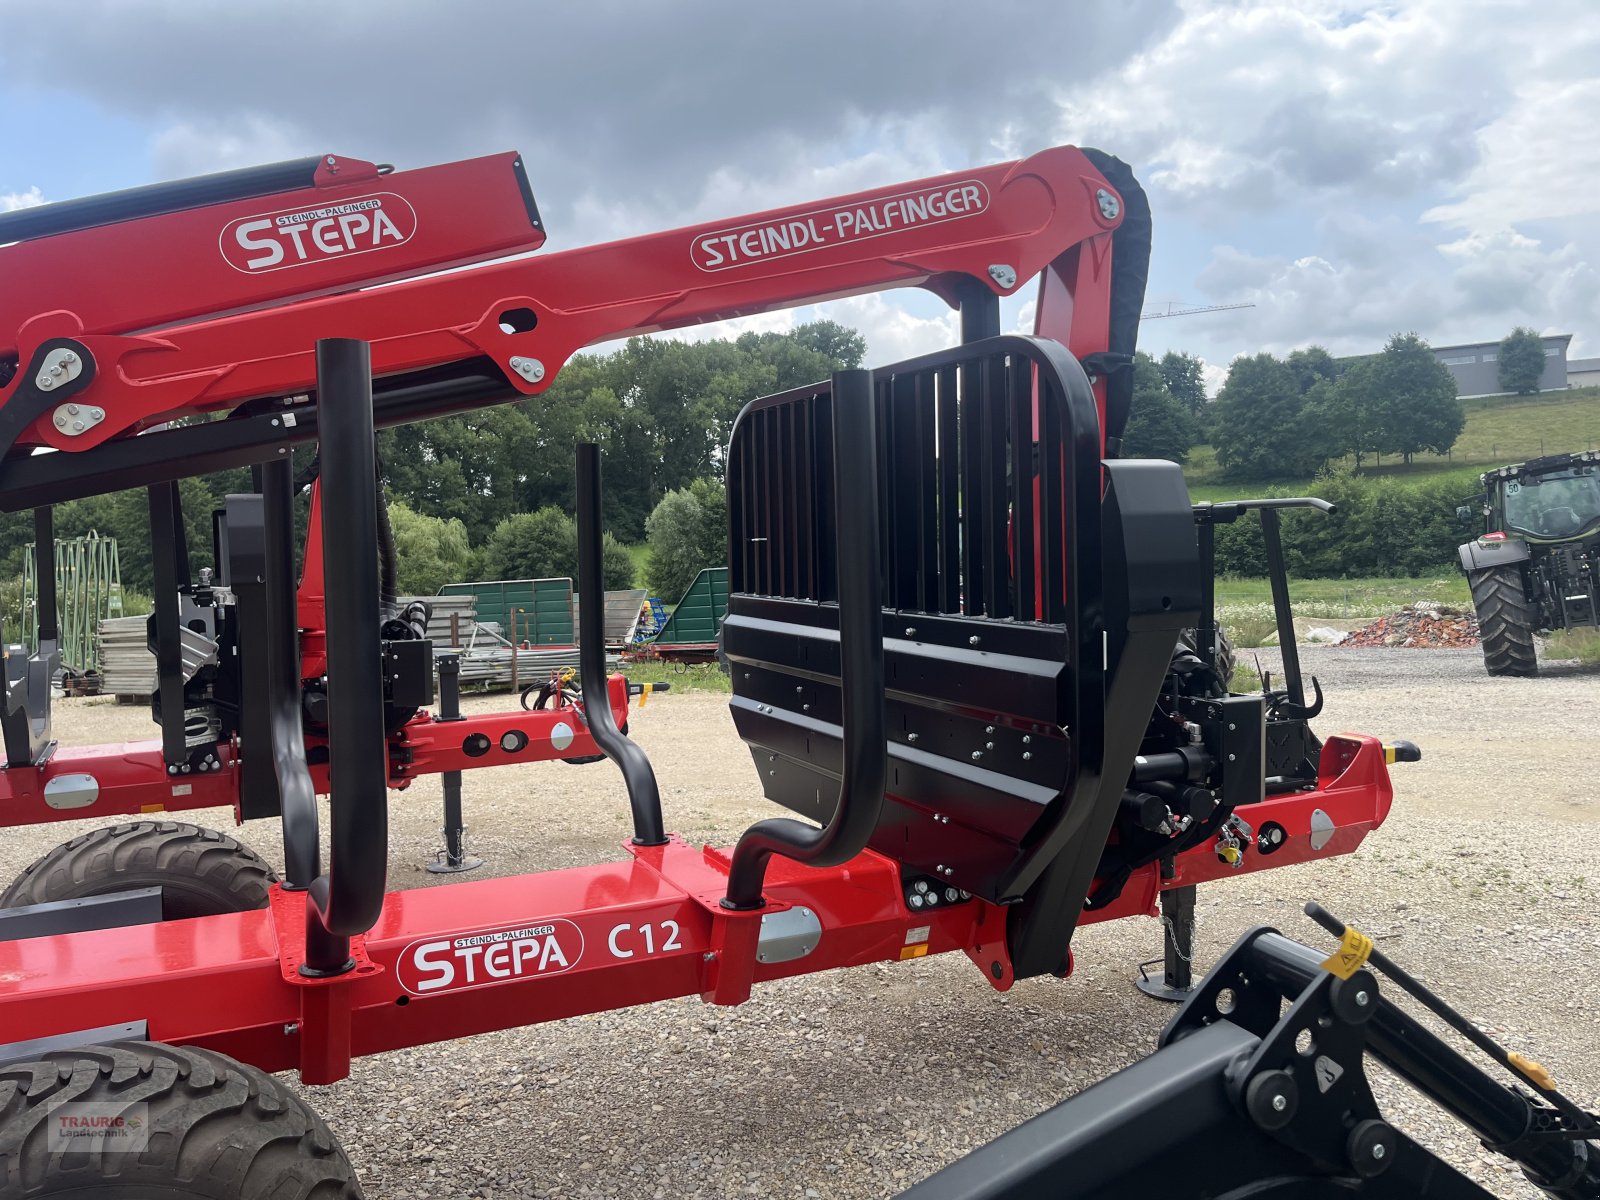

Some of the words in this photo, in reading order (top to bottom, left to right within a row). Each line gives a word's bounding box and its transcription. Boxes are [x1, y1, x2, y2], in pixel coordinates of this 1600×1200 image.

[278, 200, 379, 225] STEINDL-PALFINGER
[701, 185, 982, 267] STEINDL-PALFINGER
[235, 208, 404, 269] STEPA
[1508, 483, 1519, 494] 50
[456, 925, 554, 948] STEINDL-PALFINGER
[413, 935, 569, 991] STEPA
